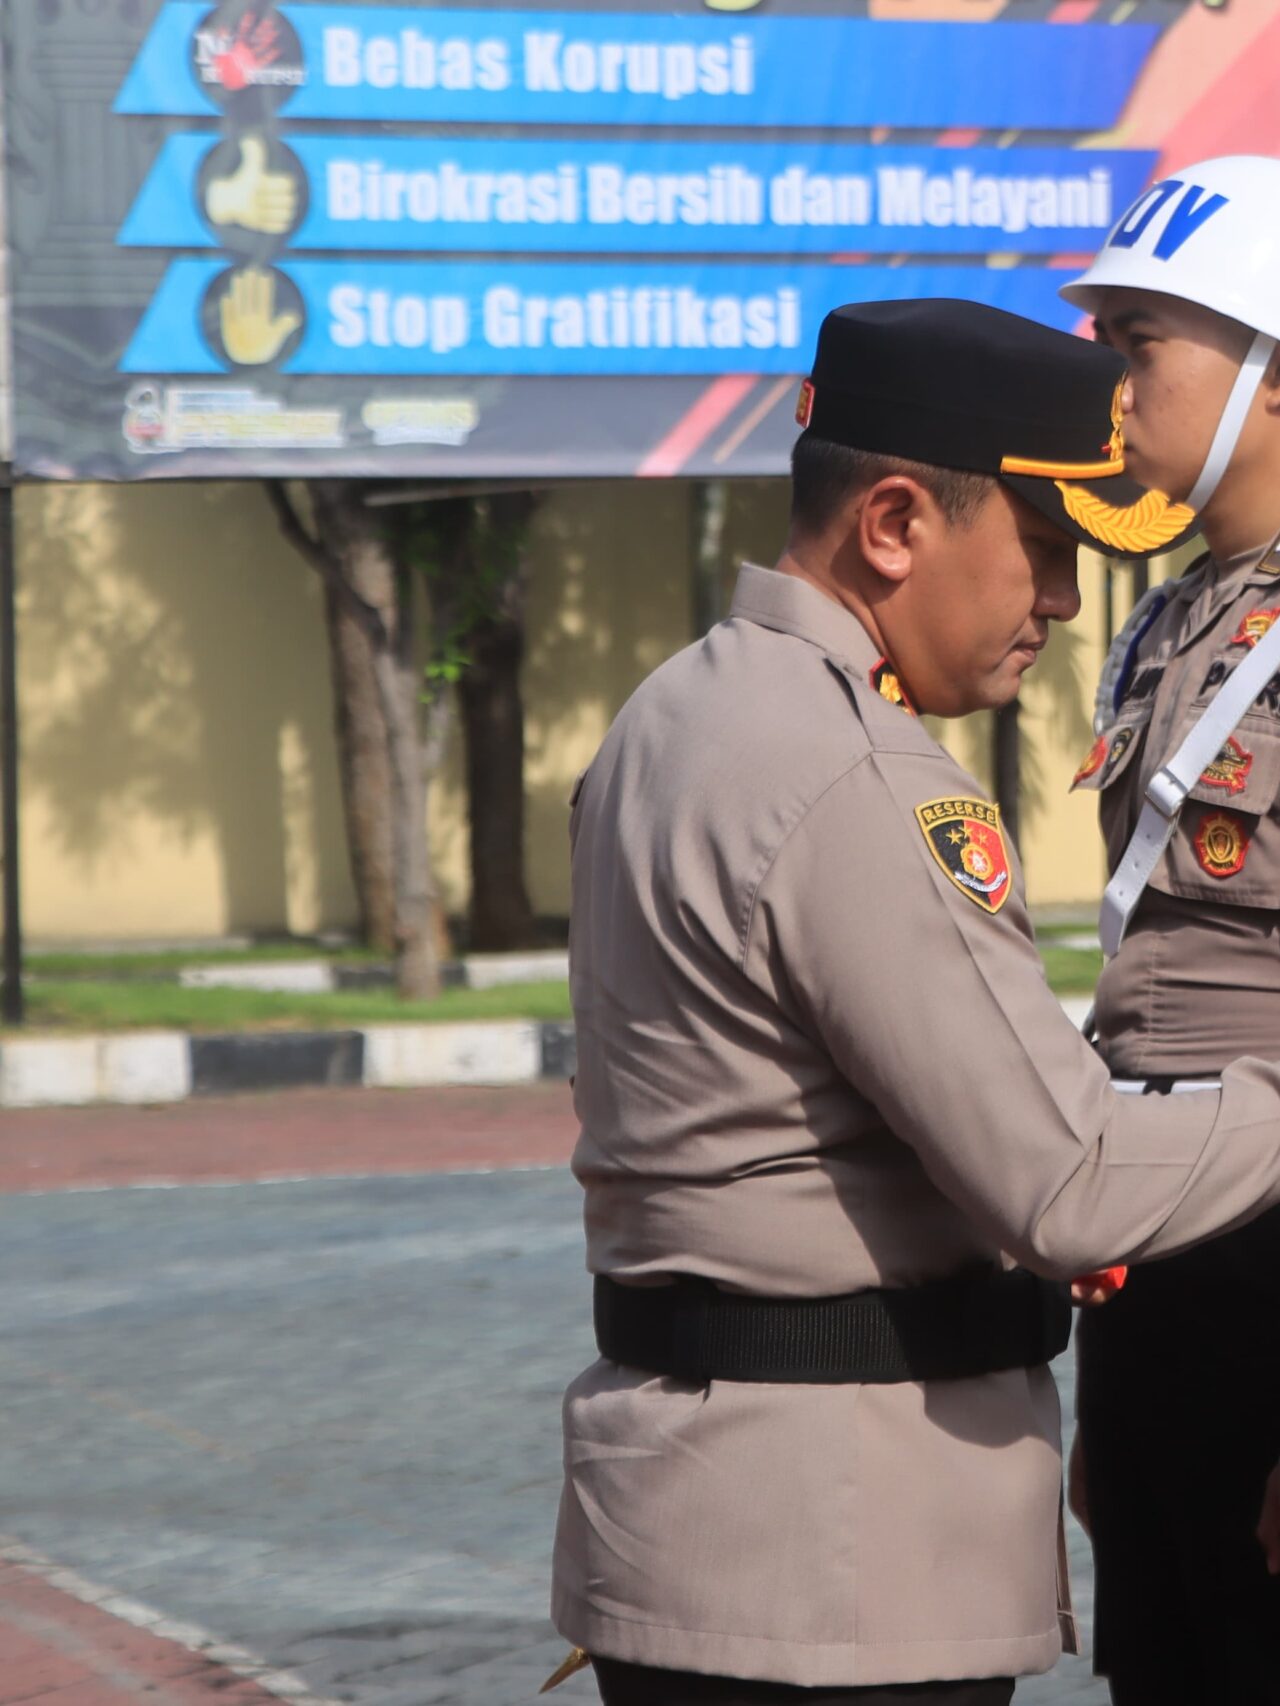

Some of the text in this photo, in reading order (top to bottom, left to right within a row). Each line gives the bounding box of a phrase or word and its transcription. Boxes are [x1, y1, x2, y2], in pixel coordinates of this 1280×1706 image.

[322, 26, 754, 99] Bebas Korupsi
[327, 160, 1111, 234] Birokrasi Bersih dan Melayani
[1108, 179, 1230, 262] OV
[328, 285, 800, 353] Stop Gratifikasi
[922, 802, 997, 824] RESERSE
